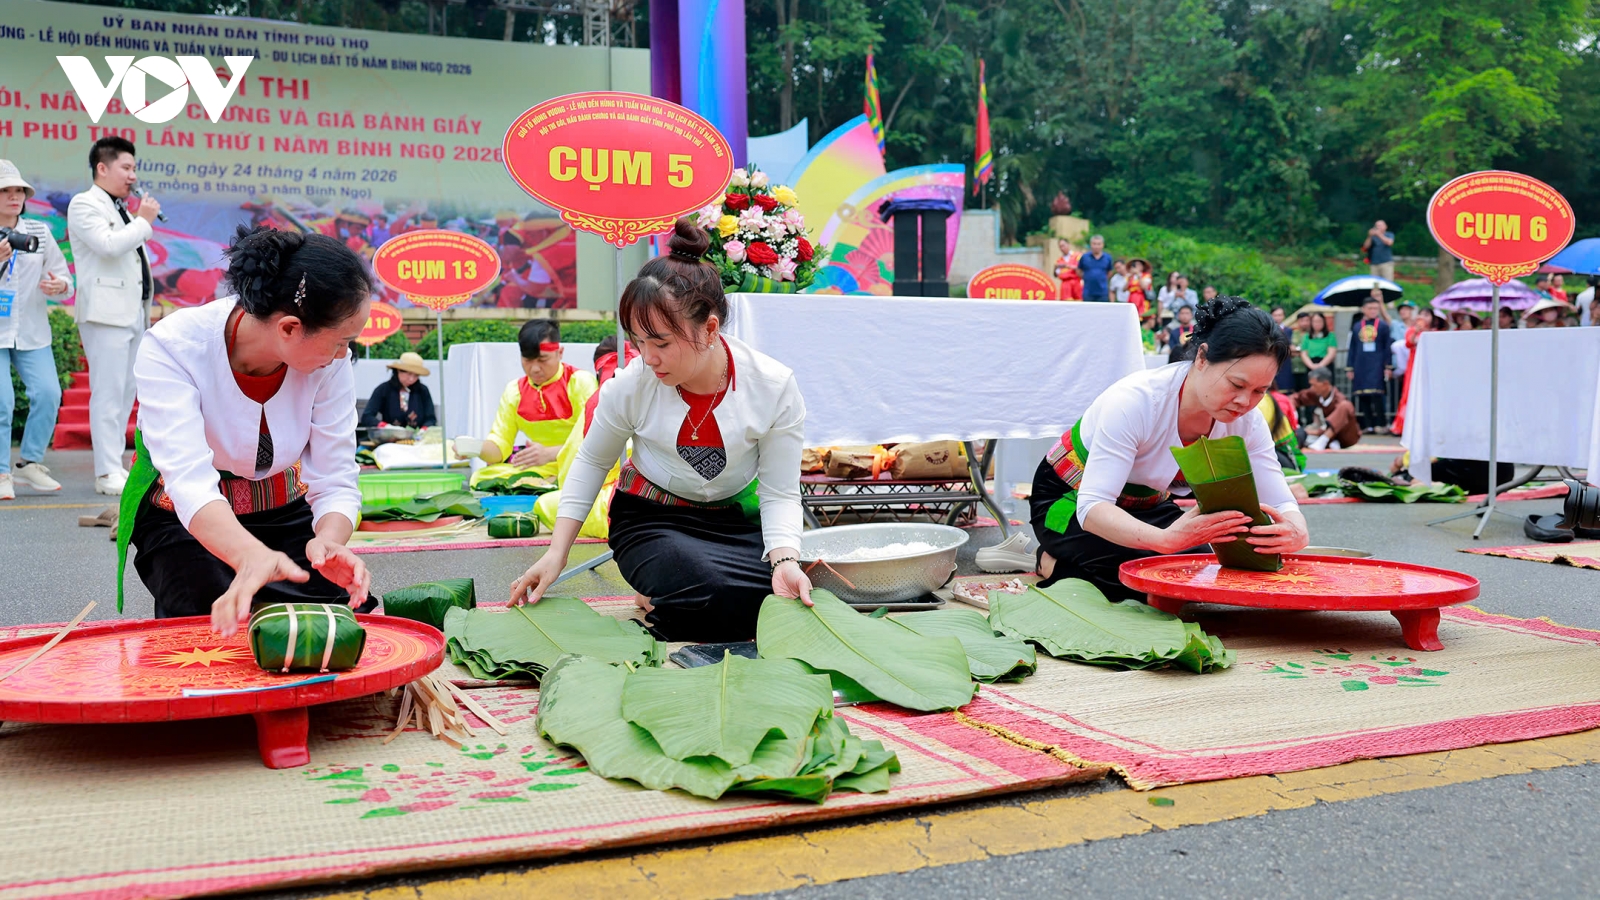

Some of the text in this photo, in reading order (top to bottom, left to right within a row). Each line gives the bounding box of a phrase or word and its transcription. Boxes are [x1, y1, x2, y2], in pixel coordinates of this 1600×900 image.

[131, 18, 166, 33] BAN
[172, 22, 218, 38] NHÂN
[225, 26, 258, 40] DÂN
[341, 37, 369, 51] THỌ
[58, 30, 80, 47] HỘI
[153, 38, 169, 53] VÀ
[273, 50, 288, 62] DU
[291, 52, 317, 66] LỊCH
[362, 56, 388, 69] NĂM
[420, 61, 443, 75] NGỌ
[445, 63, 472, 76] 2026
[258, 76, 309, 101] THI
[279, 106, 309, 127] VÀ
[317, 109, 356, 129] GIÃ
[363, 111, 425, 132] BÁNH
[23, 121, 78, 141] PHÚ
[203, 130, 252, 151] THỨ
[258, 135, 265, 152] I
[273, 135, 329, 155] NĂM
[337, 138, 392, 157] BÍNH
[400, 143, 445, 164] NGỌ
[712, 143, 724, 158] 2026
[186, 162, 227, 178] ngày
[233, 163, 252, 176] 24
[257, 165, 303, 182] tháng
[308, 167, 317, 178] 4
[322, 168, 356, 180] năm
[361, 169, 397, 182] 2026
[549, 146, 694, 191] CỤM 5
[203, 181, 212, 192] 8
[216, 182, 256, 198] tháng
[260, 184, 268, 194] 3
[272, 185, 301, 195] năm
[1455, 212, 1548, 245] CỤM 6
[397, 259, 478, 284] CỤM 13
[375, 316, 391, 329] 10
